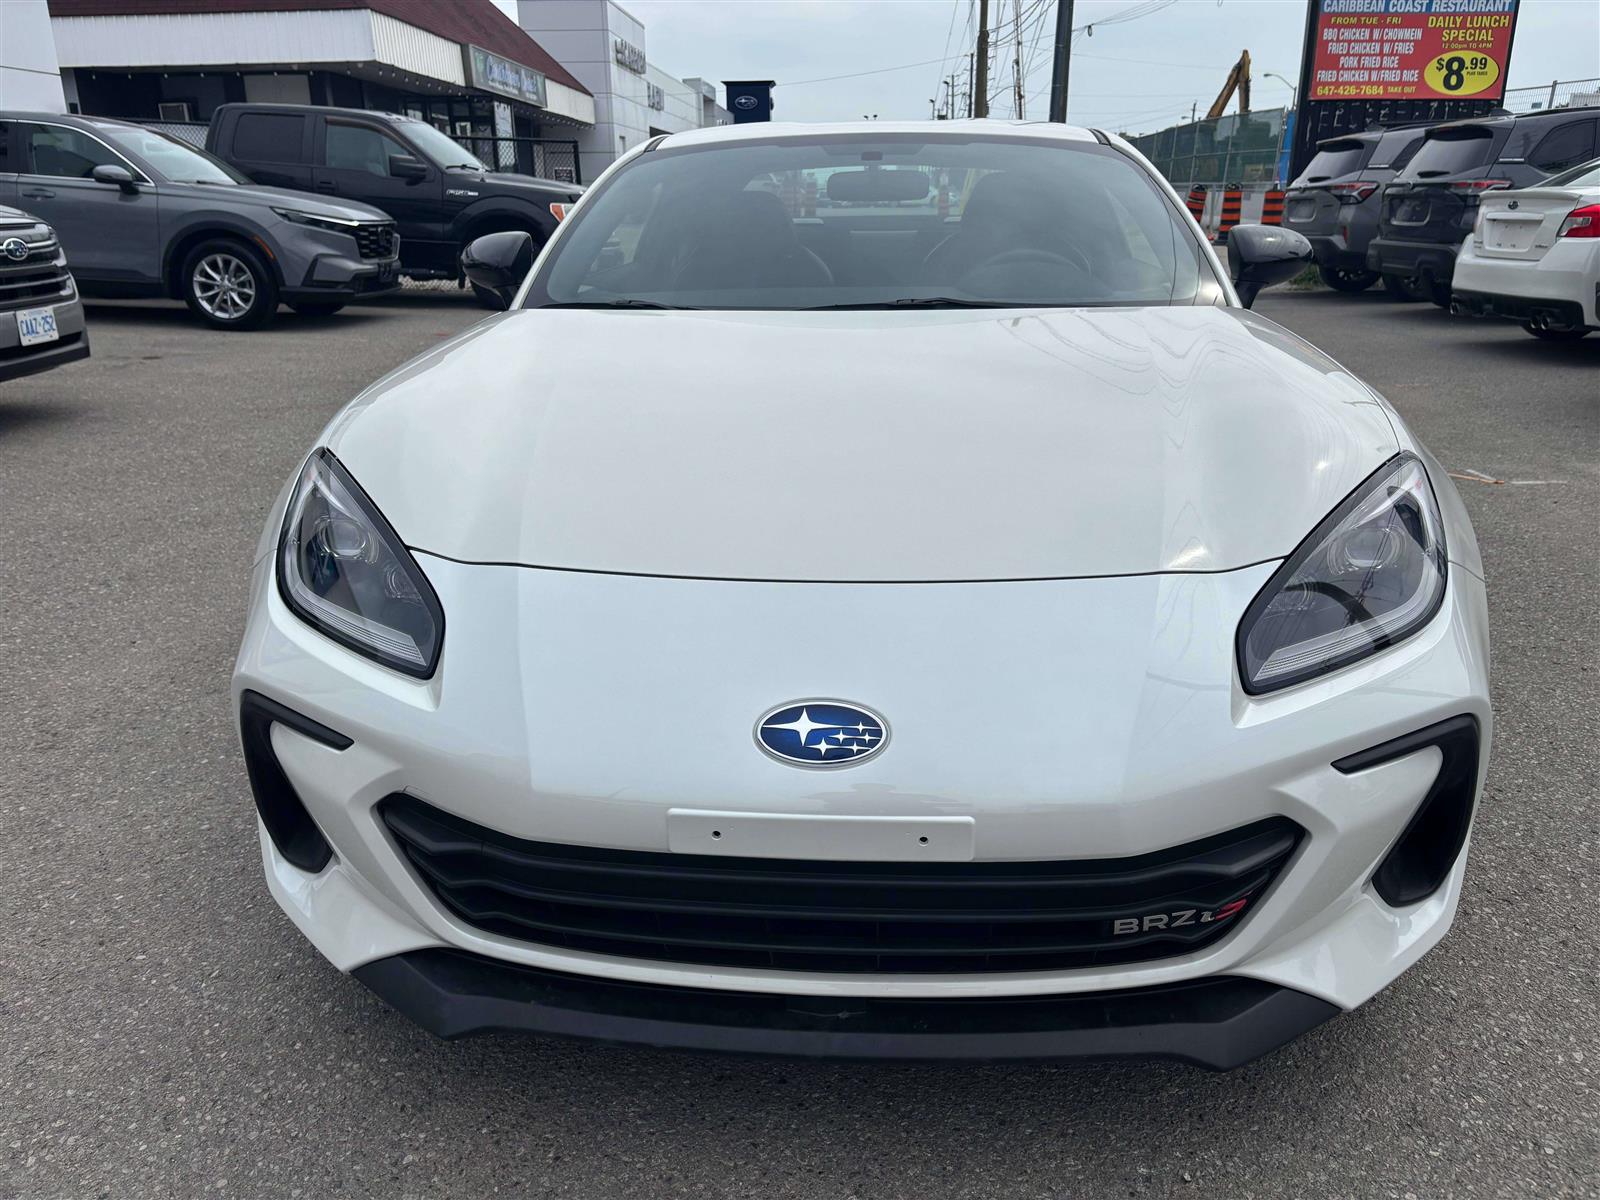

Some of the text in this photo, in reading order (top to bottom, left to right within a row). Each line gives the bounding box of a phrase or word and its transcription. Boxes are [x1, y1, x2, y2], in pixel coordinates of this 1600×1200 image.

[1323, 0, 1512, 13] CARIBBEAN COAST RESTAURANT
[1331, 16, 1358, 25] FROM
[1361, 16, 1379, 25] TUE
[1386, 16, 1402, 24] FRI
[1427, 15, 1510, 28] DAILY LUNCH
[1323, 28, 1339, 42] BBQ
[1339, 28, 1371, 41] CHICKEN
[1441, 29, 1495, 41] SPECIAL
[1327, 42, 1349, 55] FRIED
[1349, 42, 1381, 55] CHICKEN
[1339, 56, 1400, 68] PORK FRIED RICE
[1316, 70, 1338, 83] FRIED
[1338, 70, 1370, 82] CHICKEN
[1402, 69, 1420, 82] RICE
[1435, 55, 1488, 92] $8.99
[1316, 85, 1384, 96] 647-426-7684
[1403, 85, 1417, 93] OUT
[1113, 909, 1197, 935] BRZ
